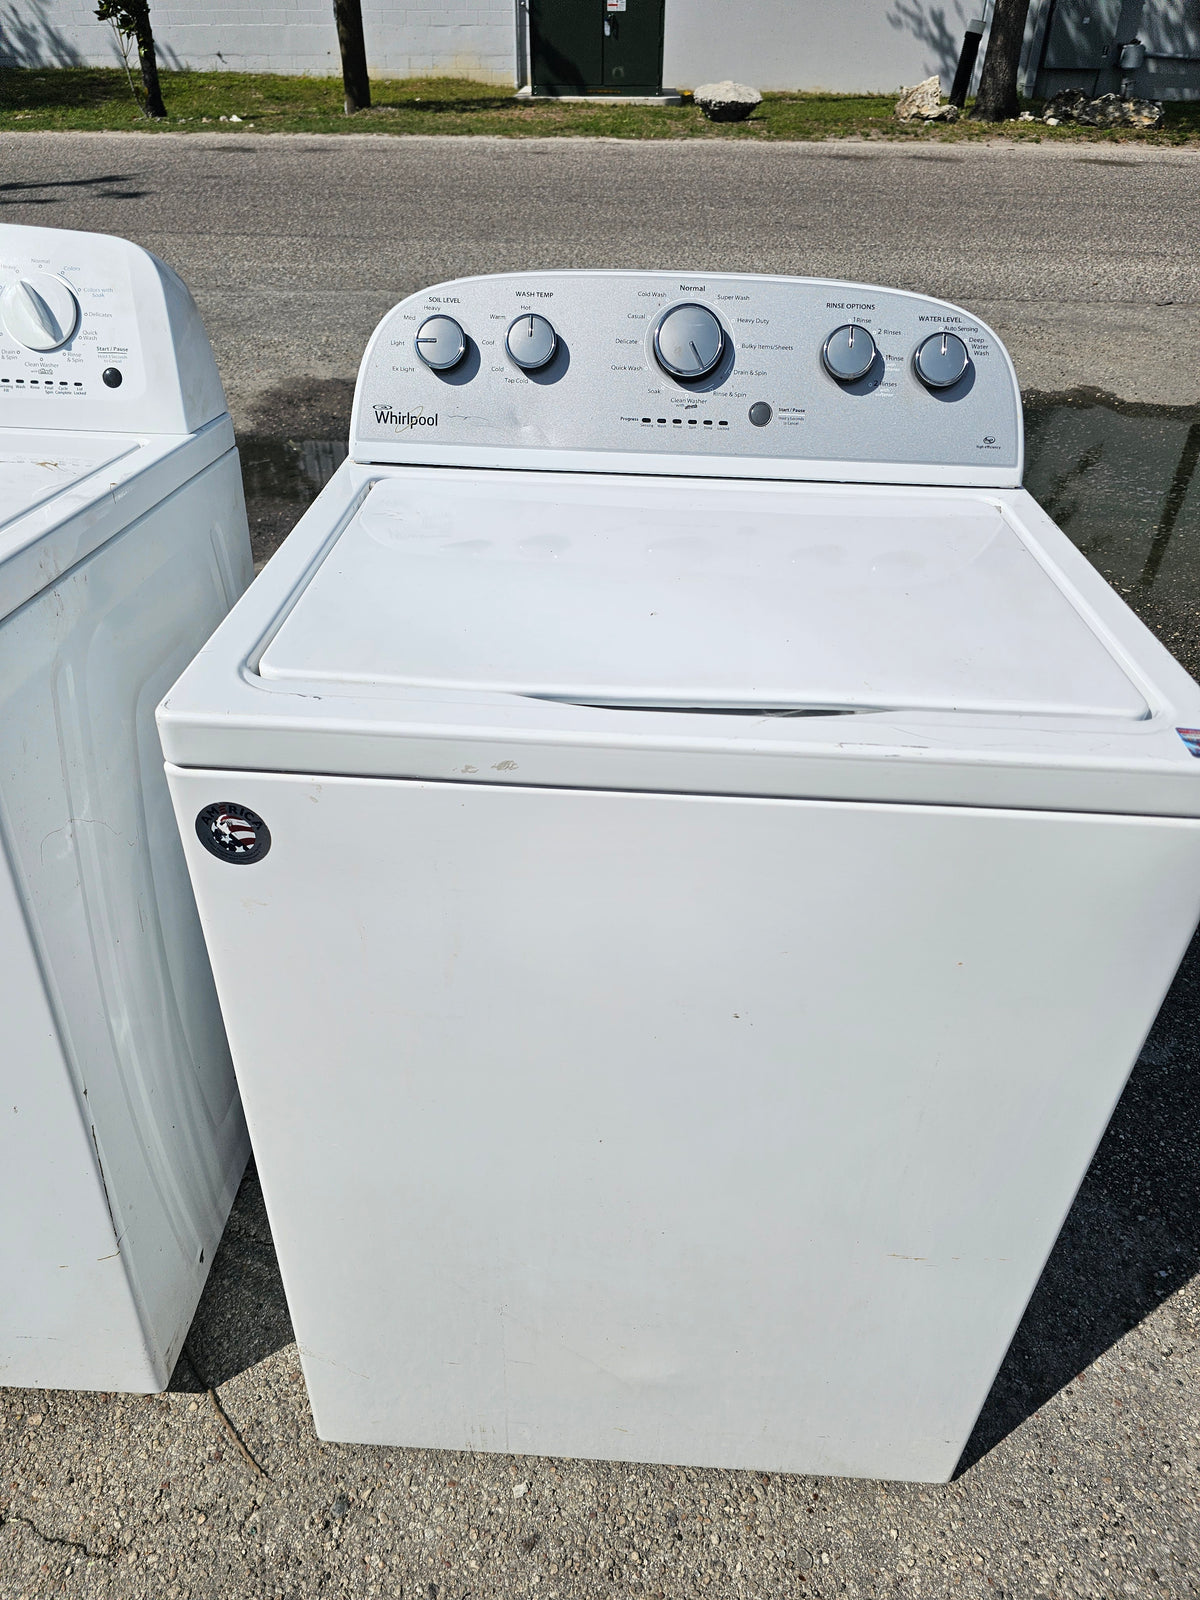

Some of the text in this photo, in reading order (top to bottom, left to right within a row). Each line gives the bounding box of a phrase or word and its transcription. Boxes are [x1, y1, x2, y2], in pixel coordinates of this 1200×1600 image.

[679, 284, 706, 292] Normal
[374, 410, 438, 429] Whirlpool
[200, 803, 264, 831] AMERICA
